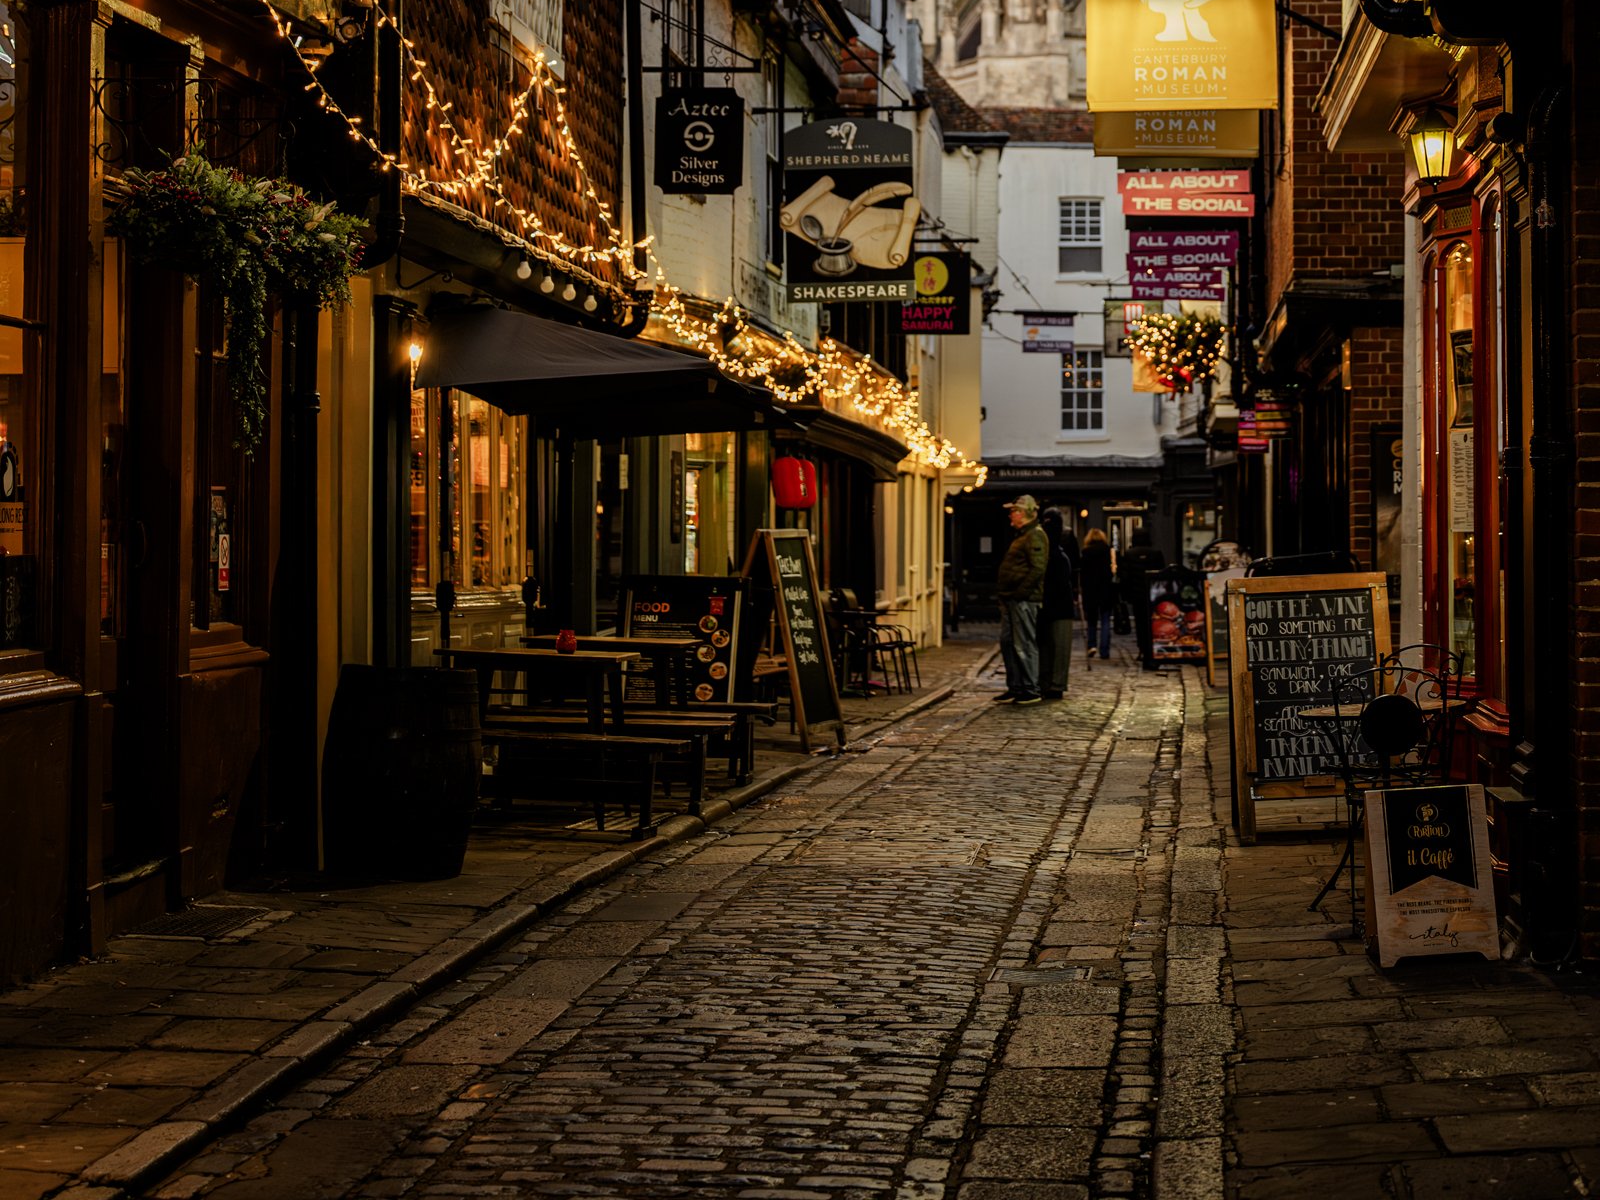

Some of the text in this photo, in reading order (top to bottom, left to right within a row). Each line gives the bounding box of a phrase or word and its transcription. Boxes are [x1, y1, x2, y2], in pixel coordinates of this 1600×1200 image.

[1134, 54, 1227, 65] CANTERBURY
[1135, 65, 1227, 81] ROMAN
[1142, 83, 1219, 94] MUSEUM
[668, 97, 730, 116] Aztec
[1135, 118, 1217, 132] ROMAN
[1142, 133, 1209, 143] MUSEUM
[680, 156, 719, 169] Silver
[787, 153, 910, 166] SHEPHERD NEAME
[671, 170, 725, 187] Designs
[1125, 175, 1239, 190] ALL ABOUT
[1131, 197, 1249, 212] THE SOCIAL
[1136, 234, 1231, 247] ALL ABOUT
[1133, 251, 1232, 267] THE SOCIAL
[1133, 272, 1214, 282] ALL ABOUT
[793, 284, 908, 299] SHAKESPEARE
[1135, 286, 1220, 299] THE SOCIAL
[901, 306, 953, 320] HAPPY
[901, 320, 954, 331] SAMURAI
[0, 507, 14, 524] ONG
[634, 602, 671, 613] FOOD
[1320, 596, 1369, 617] WINE
[633, 614, 659, 622] MENU
[1247, 617, 1369, 636] AND SOMETHING FINE
[1327, 662, 1355, 677] CAKE
[1268, 681, 1278, 695] &
[1289, 680, 1322, 695] DRINK
